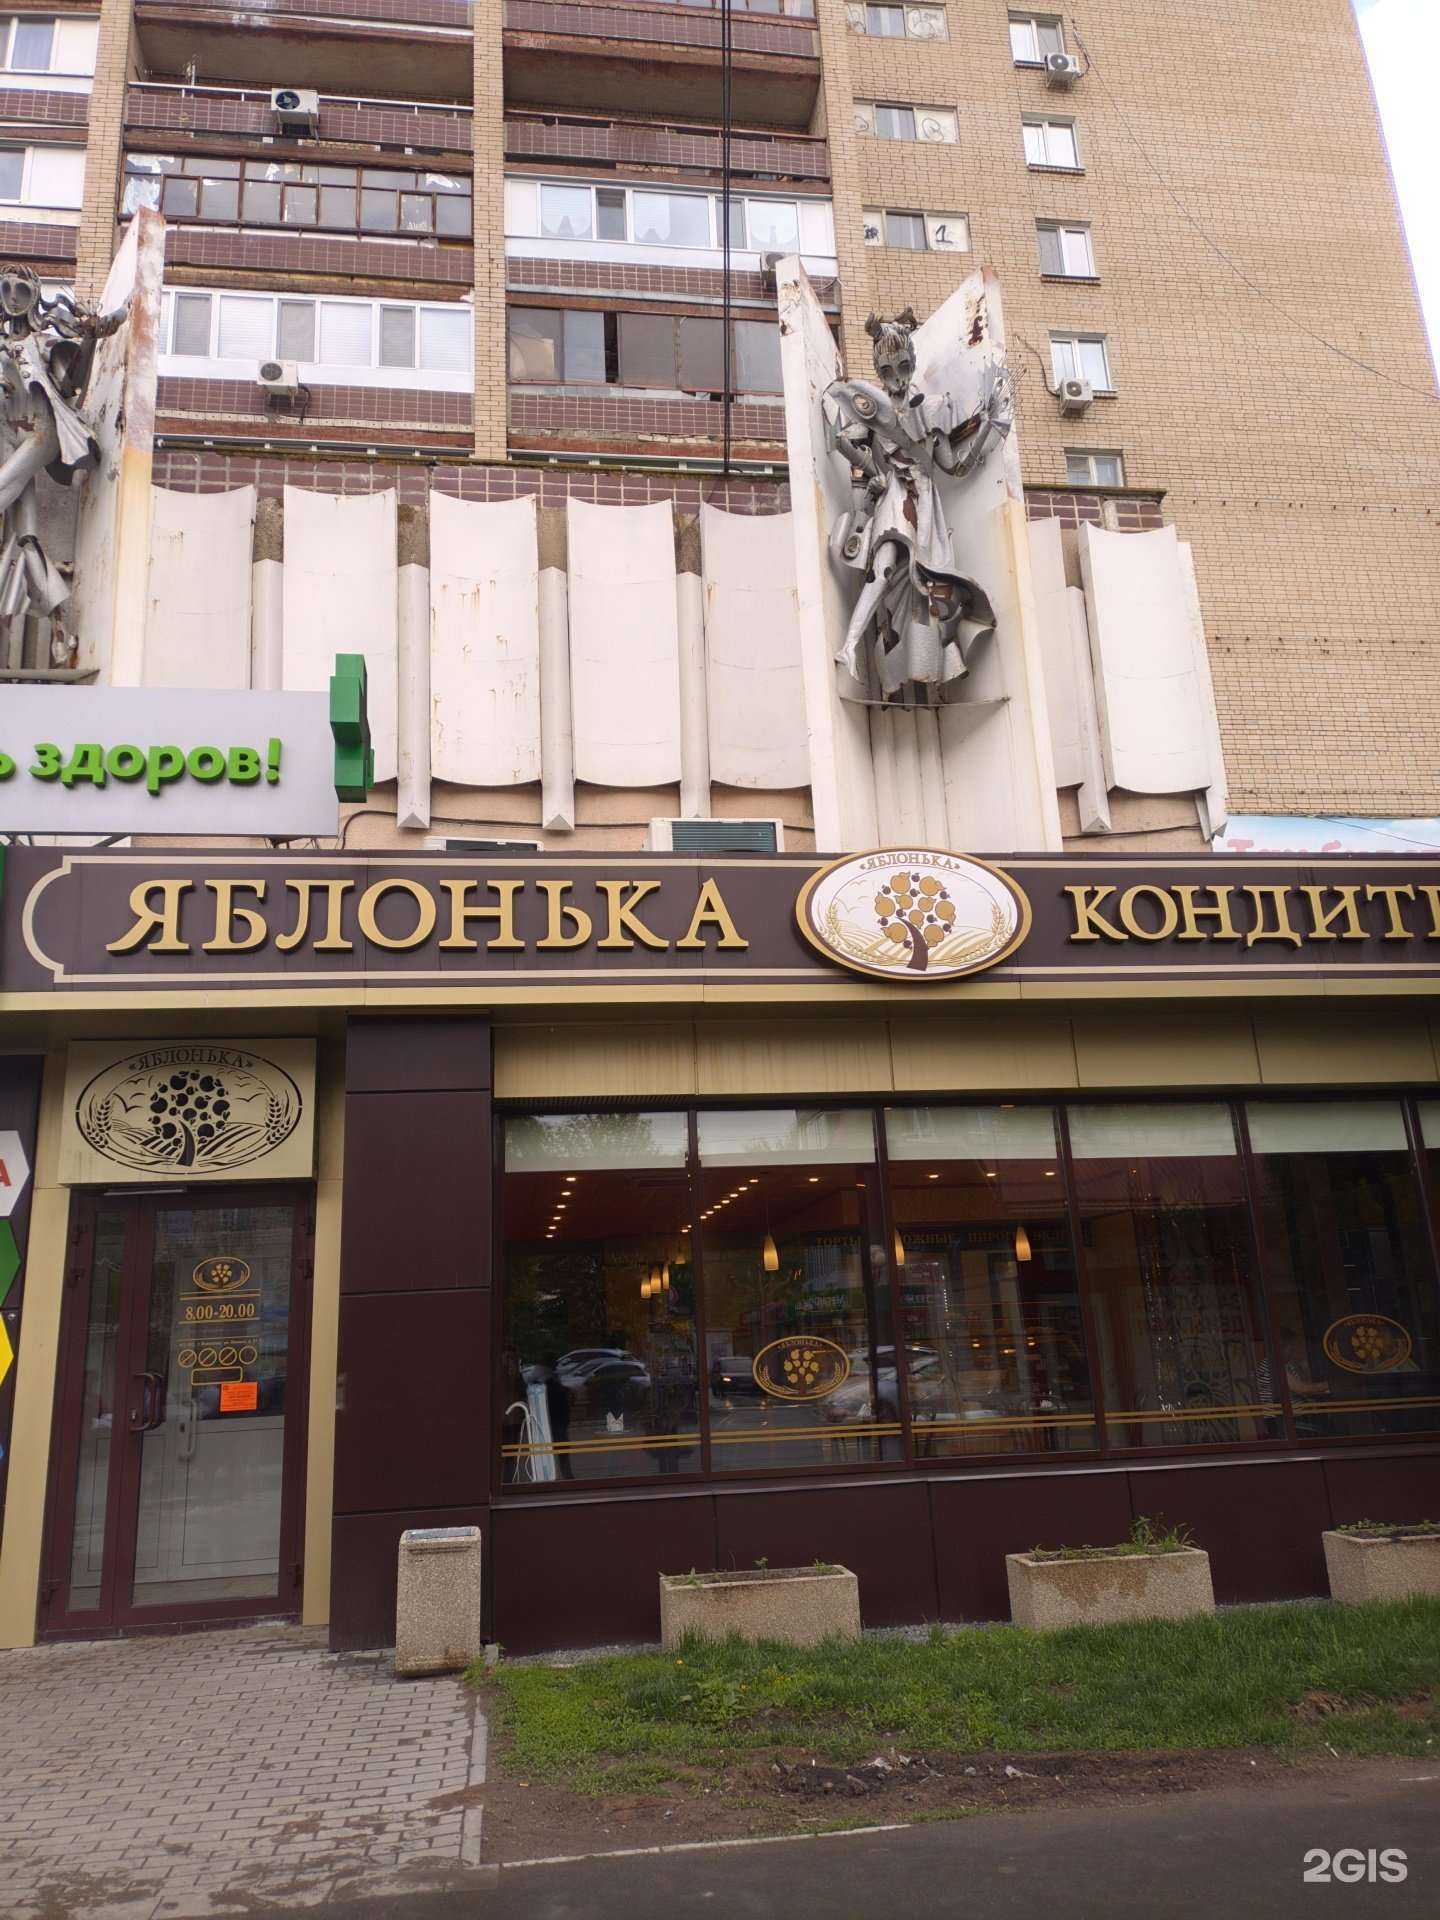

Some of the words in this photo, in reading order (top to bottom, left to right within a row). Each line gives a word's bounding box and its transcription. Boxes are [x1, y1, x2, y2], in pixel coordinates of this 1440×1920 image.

[30, 738, 282, 796] здоров!
[106, 877, 749, 953] ЯБЛОНЬКА
[185, 1303, 255, 1321] 8.00-20.00
